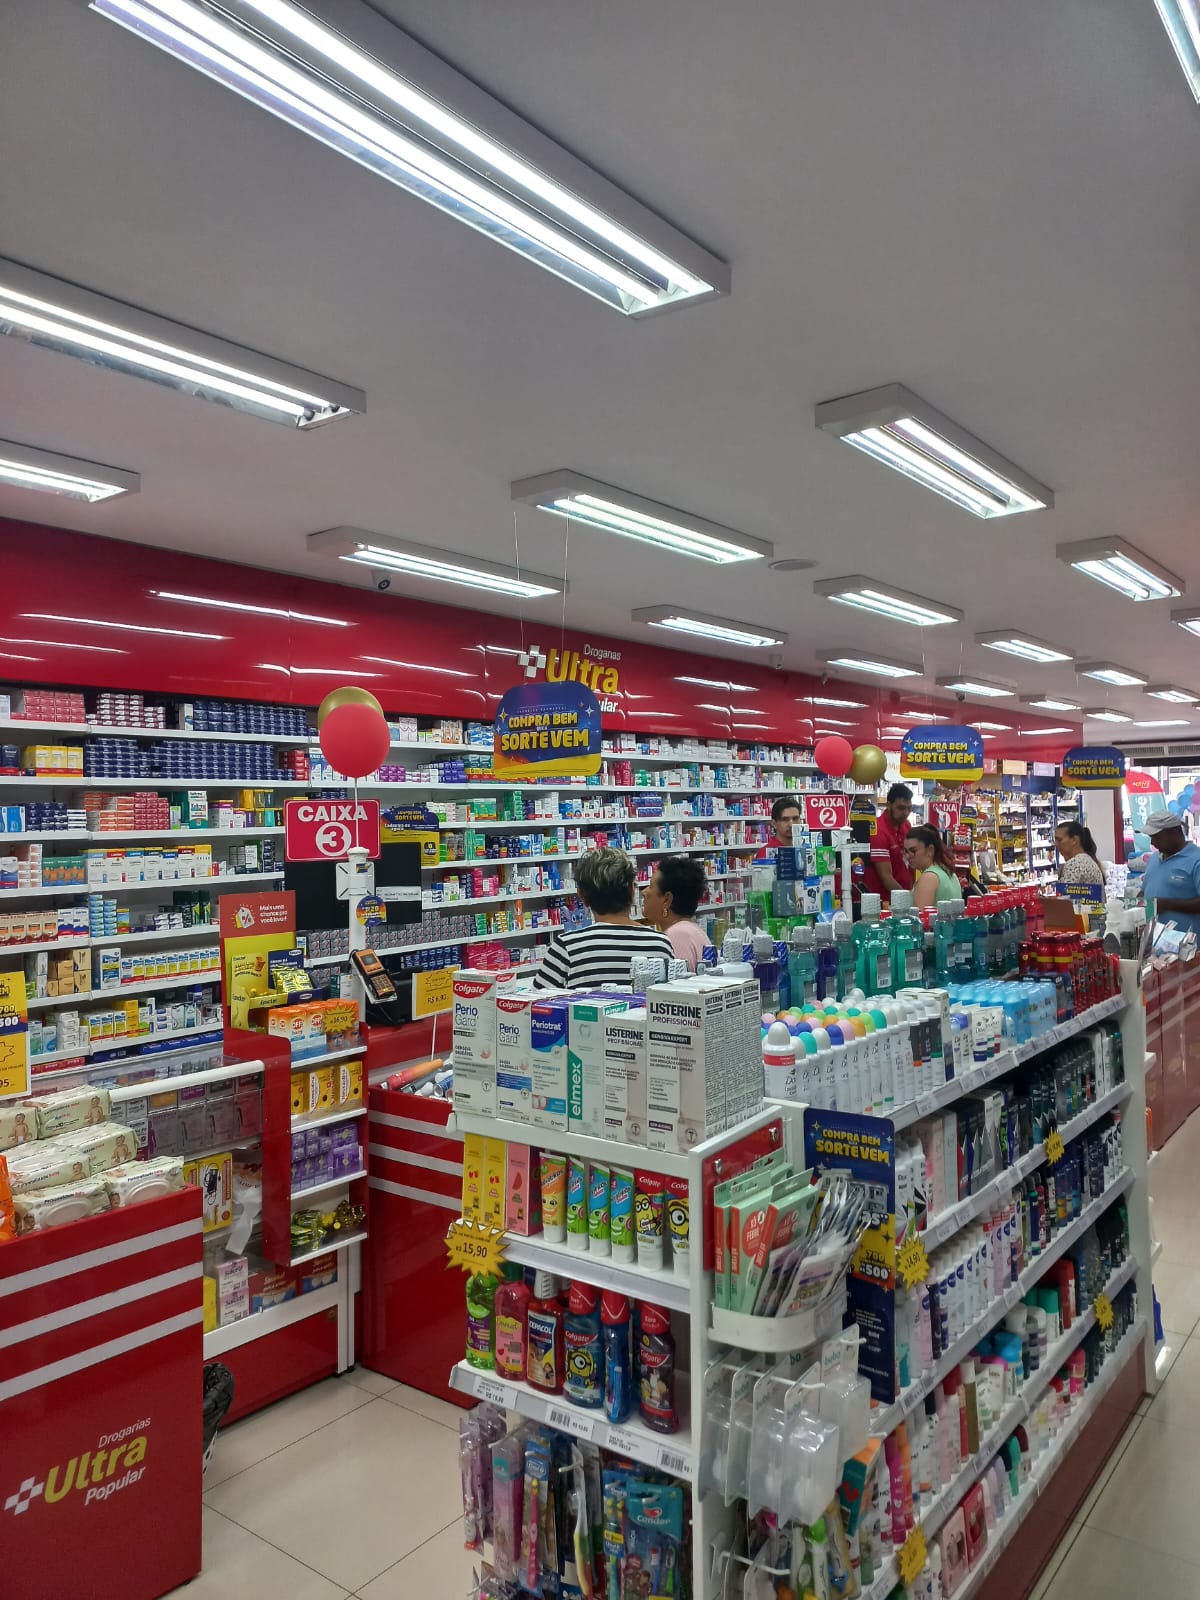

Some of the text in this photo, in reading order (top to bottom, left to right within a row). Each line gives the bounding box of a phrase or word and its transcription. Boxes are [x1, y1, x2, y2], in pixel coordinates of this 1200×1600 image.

[546, 648, 619, 694] Ultra
[508, 711, 578, 729] COMPRA BEM
[501, 728, 589, 752] SORTE VEM
[913, 742, 968, 751] COMPRA BEM
[906, 751, 975, 764] SORTE VEM
[1067, 766, 1120, 776] SORTE VEM
[810, 797, 844, 807] CAIXA
[297, 805, 368, 822] CAIXA
[822, 808, 834, 826] 2
[321, 825, 345, 854] 3
[453, 983, 486, 994] Colgate
[455, 1003, 478, 1016] Perio
[498, 1000, 525, 1010] Colgate
[650, 1002, 702, 1019] LISTERINE
[455, 1014, 477, 1027] Gard
[531, 1019, 562, 1031] Periotrat
[652, 1016, 700, 1028] PROFISSIONAL
[499, 1023, 520, 1035] Perio
[605, 1027, 644, 1041] LISTERINE
[499, 1033, 519, 1044] Gard
[607, 1038, 643, 1047] PROFISSIONAL
[569, 1063, 581, 1116] elmex
[822, 1129, 881, 1146] COMPRA BEM
[815, 1140, 889, 1164] SORTE VEM
[639, 1176, 661, 1188] Colgate
[671, 1181, 690, 1190] Colg
[463, 1242, 488, 1258] 15,90
[565, 1330, 590, 1342] Colgate
[98, 1417, 152, 1449] Drogarias
[44, 1435, 148, 1504] Ultra
[84, 1466, 147, 1506] Popular
